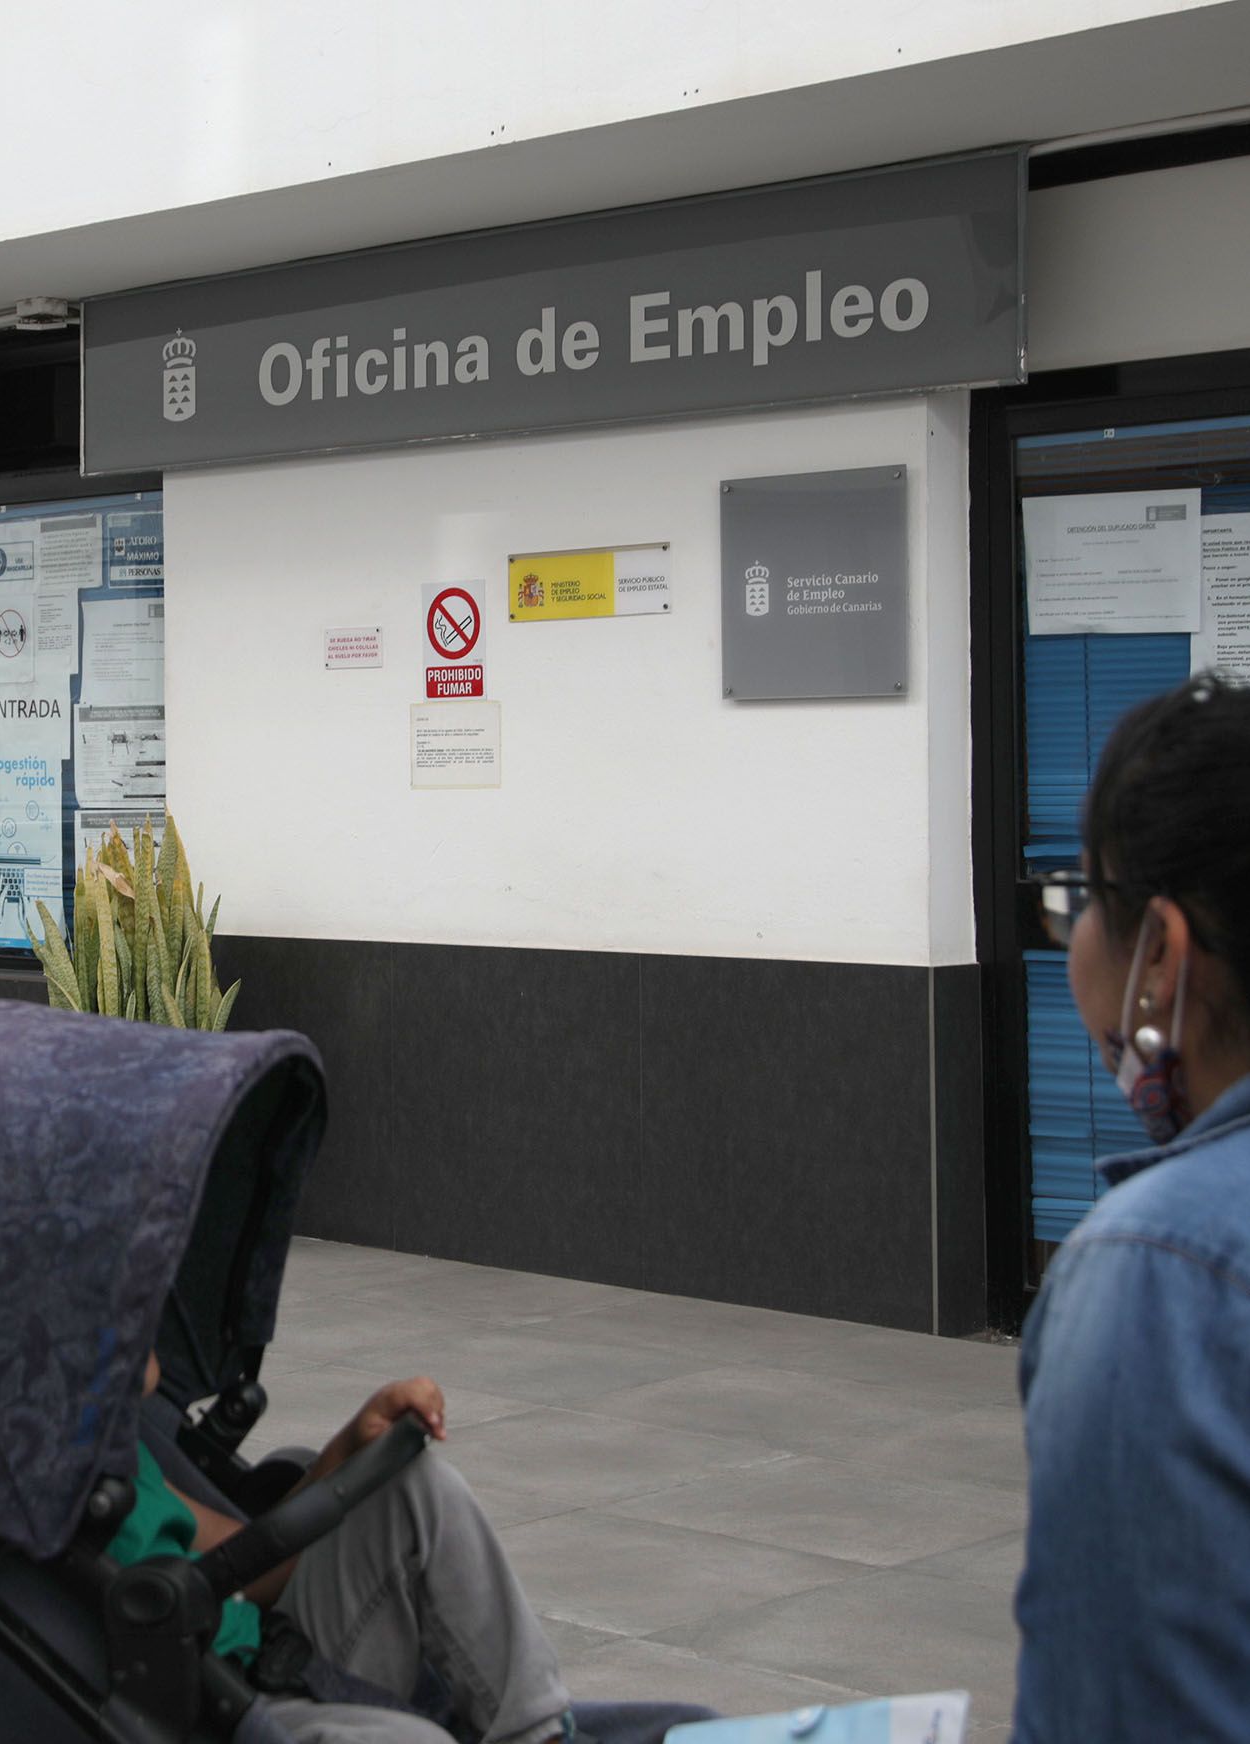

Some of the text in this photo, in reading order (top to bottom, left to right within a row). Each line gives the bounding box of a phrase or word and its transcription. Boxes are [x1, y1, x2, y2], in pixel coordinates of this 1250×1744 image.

[258, 269, 930, 406] Oficina de Empleo
[551, 580, 581, 588] MINISTERIO
[787, 571, 879, 588] Servicio Canario
[787, 587, 845, 602] de Empleo
[787, 601, 883, 615] Gobierno de Canarias
[427, 667, 482, 682] PROHIBIDO
[437, 682, 472, 696] FUMAR
[15, 771, 56, 790] rápida
